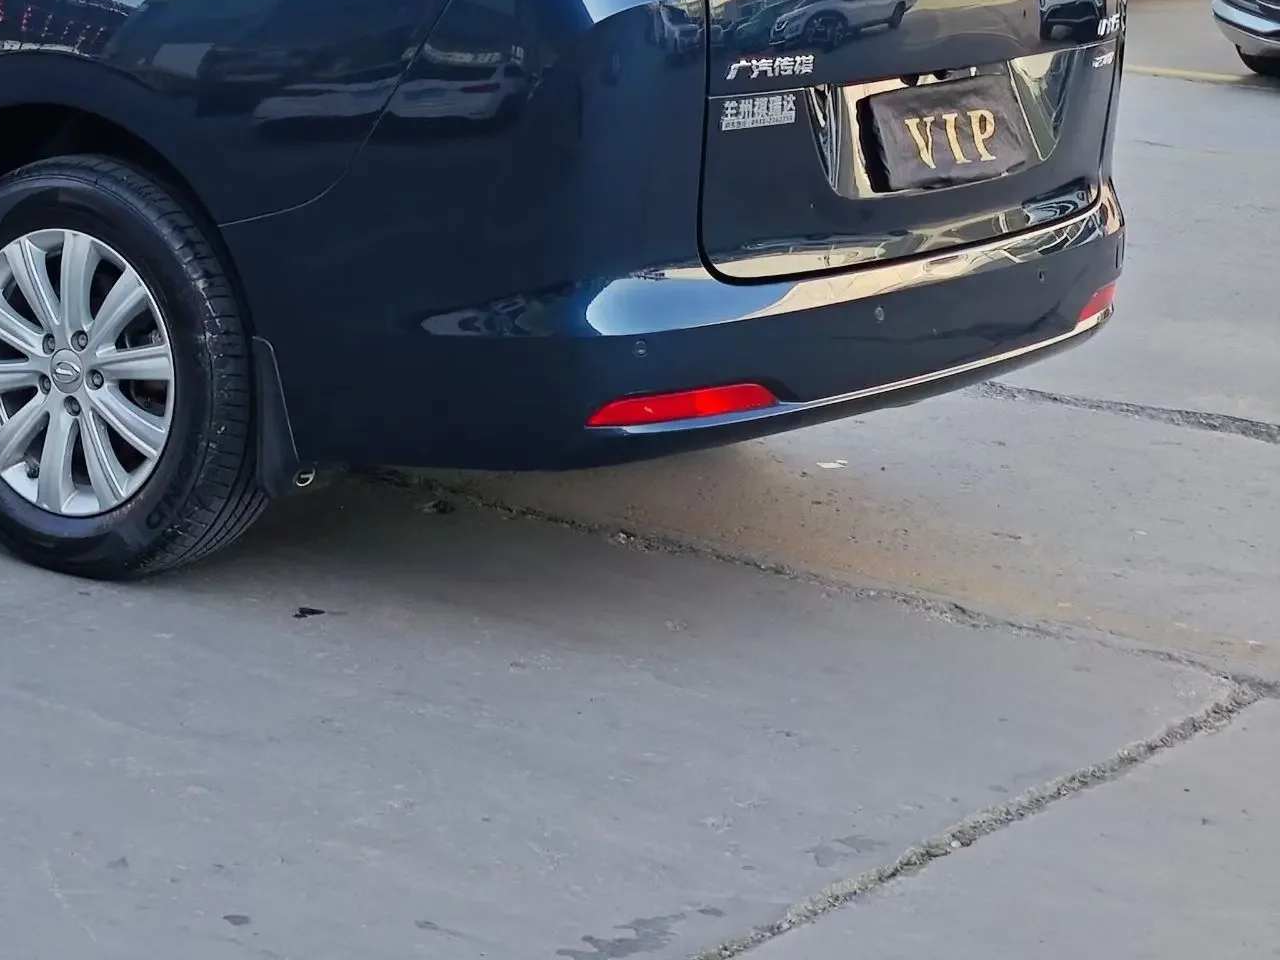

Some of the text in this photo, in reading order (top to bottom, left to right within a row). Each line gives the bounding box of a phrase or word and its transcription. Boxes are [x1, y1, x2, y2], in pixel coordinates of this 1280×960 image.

[726, 54, 815, 80] 广汽传祺
[904, 109, 997, 169] VIP
